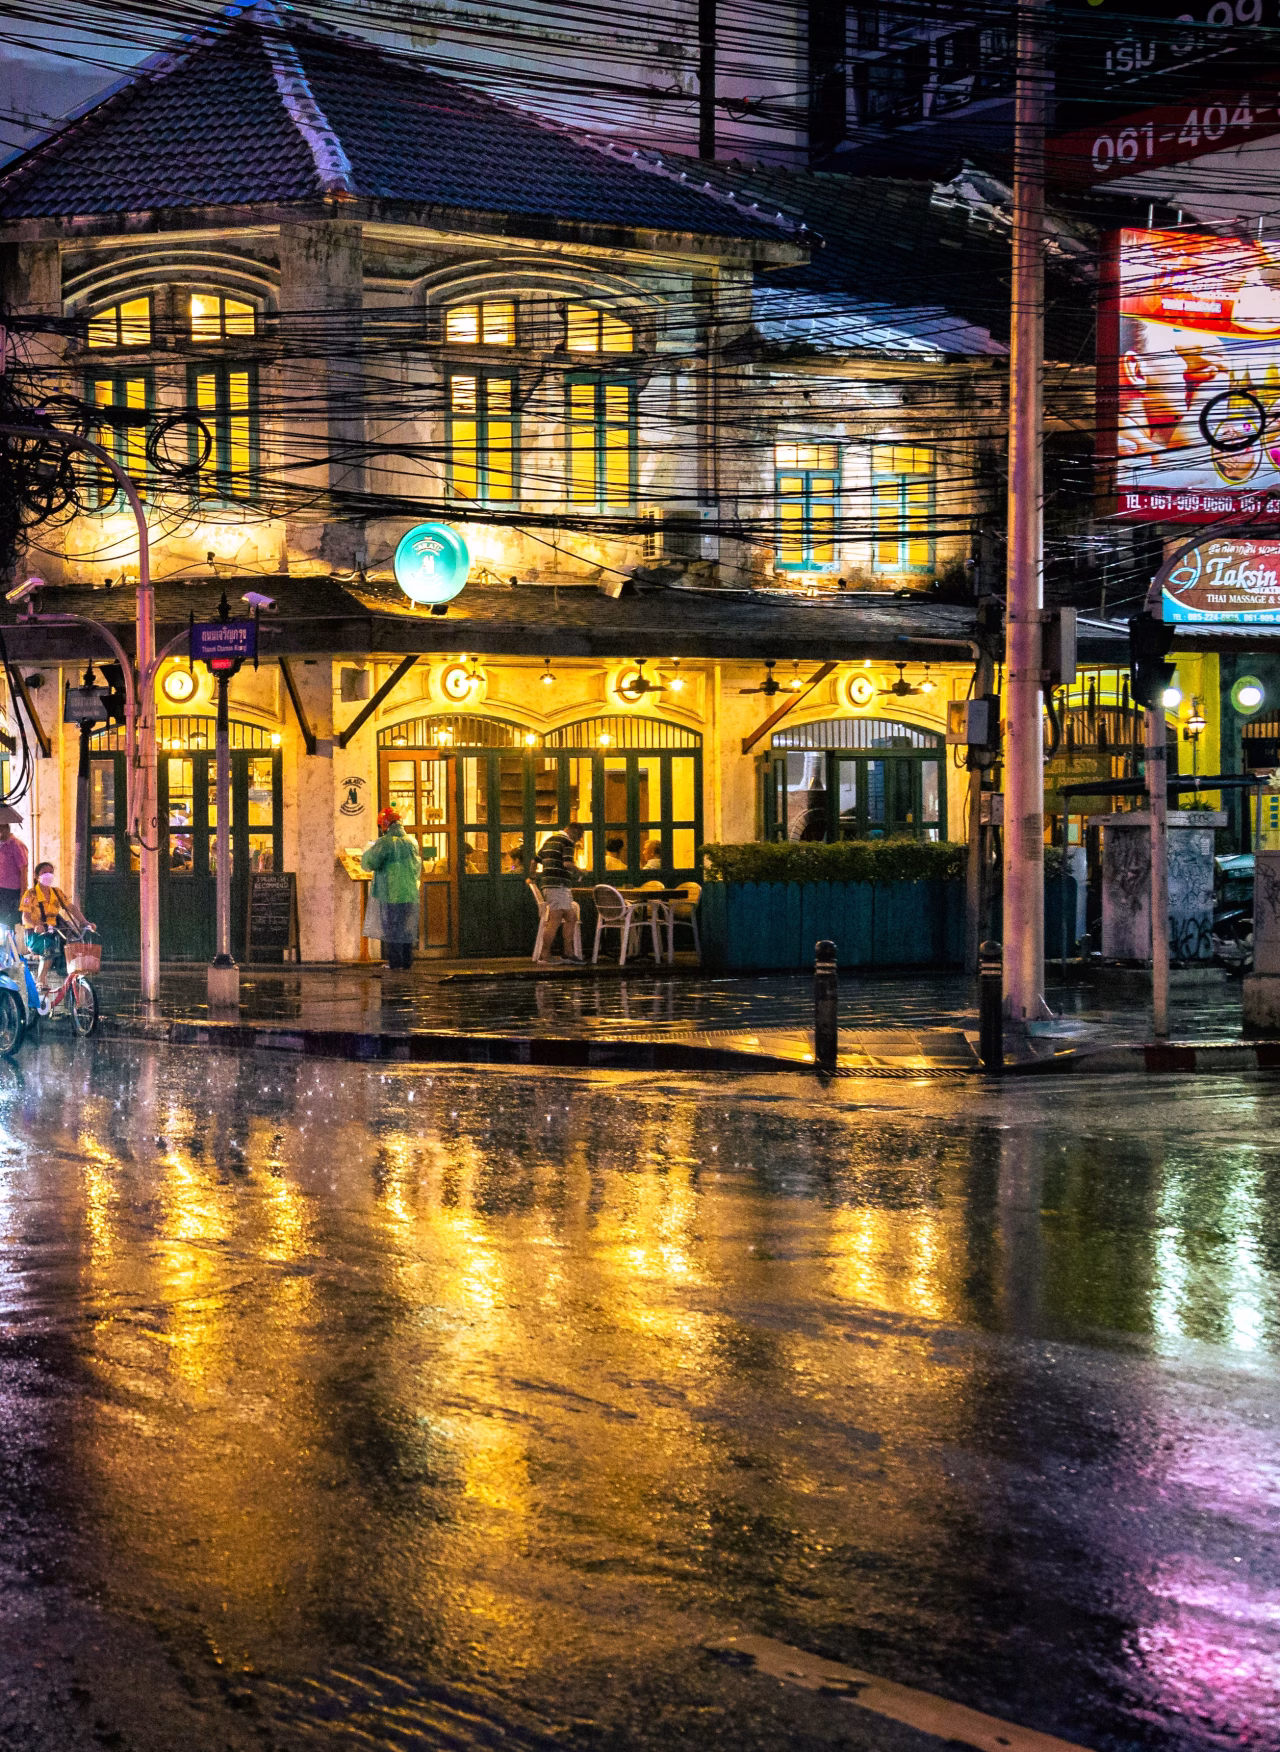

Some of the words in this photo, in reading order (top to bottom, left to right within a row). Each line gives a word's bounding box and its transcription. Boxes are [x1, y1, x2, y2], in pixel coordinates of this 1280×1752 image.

[1091, 93, 1280, 172] 061-404-
[1125, 494, 1142, 509] TEL
[1205, 555, 1278, 589] Taksin
[1206, 594, 1227, 603] THAI
[1228, 594, 1267, 604] MASSAGE
